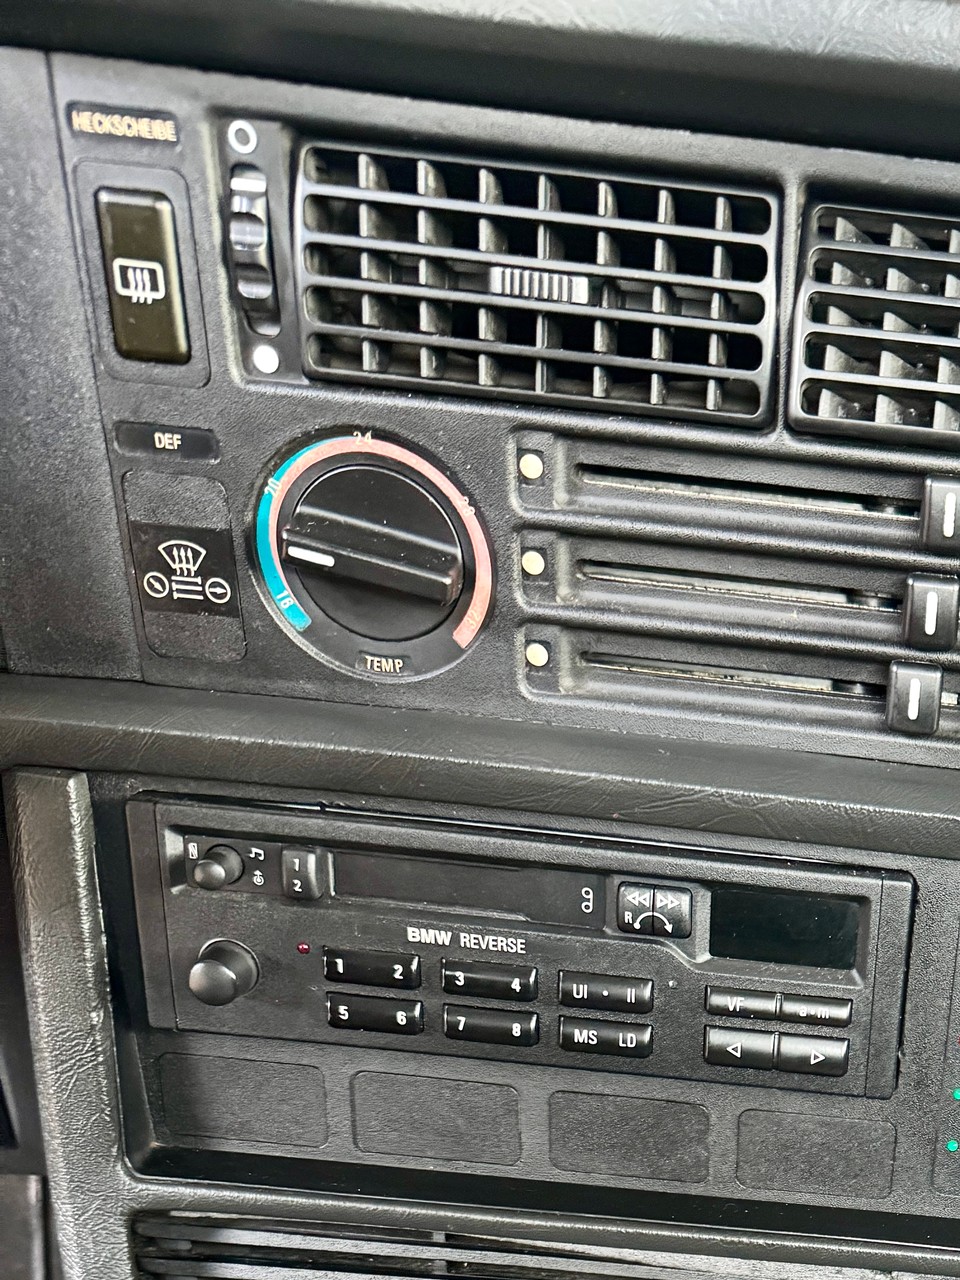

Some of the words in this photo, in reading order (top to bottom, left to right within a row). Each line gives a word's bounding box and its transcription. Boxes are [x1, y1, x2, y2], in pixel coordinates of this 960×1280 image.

[154, 433, 182, 451] DEF
[353, 431, 373, 445] 24
[365, 656, 404, 673] TEMP
[293, 858, 300, 871] 1
[292, 879, 302, 892] 2
[624, 911, 633, 924] R
[407, 927, 452, 946] BMW
[460, 932, 527, 954] REVERSE
[334, 958, 344, 974] 1
[393, 964, 404, 980] 2
[454, 971, 465, 986] 3
[511, 977, 522, 993] 4
[727, 997, 745, 1012] VF
[338, 1005, 349, 1020] 5
[396, 1011, 407, 1026] 6
[457, 1016, 466, 1031] 7
[511, 1022, 522, 1037] 8
[574, 1029, 598, 1045] MS
[618, 1032, 637, 1048] LD
